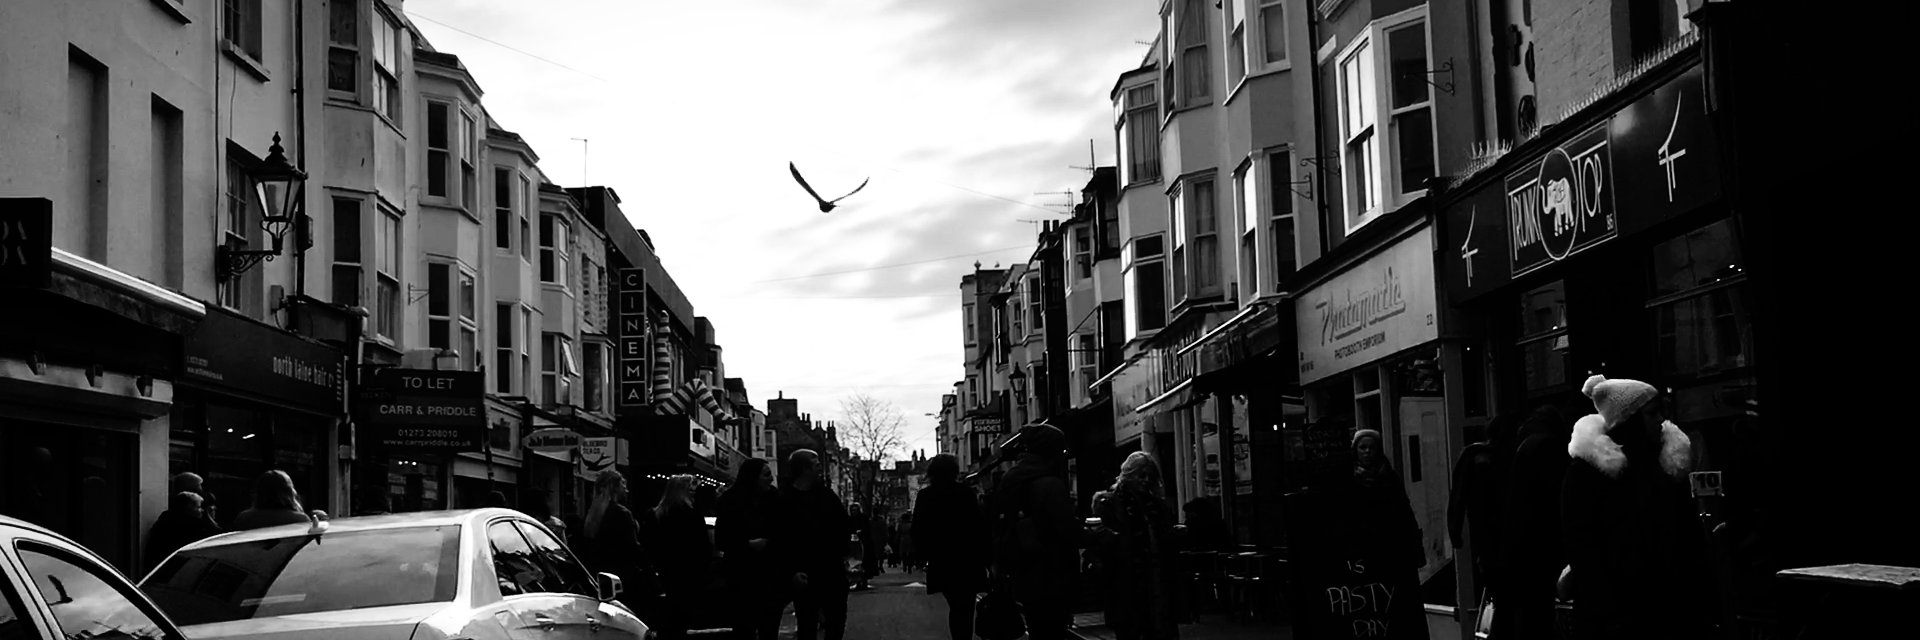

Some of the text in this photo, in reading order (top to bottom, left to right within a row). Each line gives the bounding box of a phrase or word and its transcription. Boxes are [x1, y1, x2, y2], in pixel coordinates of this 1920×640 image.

[1508, 140, 1607, 261] TRUNK TOP
[626, 273, 641, 400] CINEMA
[273, 355, 293, 378] north
[313, 364, 327, 387] hair
[402, 376, 456, 390] TO LET
[380, 404, 477, 417] CARR & PRIDDLE
[398, 429, 424, 438] 01273
[1346, 559, 1365, 574] IS
[1326, 582, 1396, 616] PASTY
[1352, 619, 1391, 638] DAY
